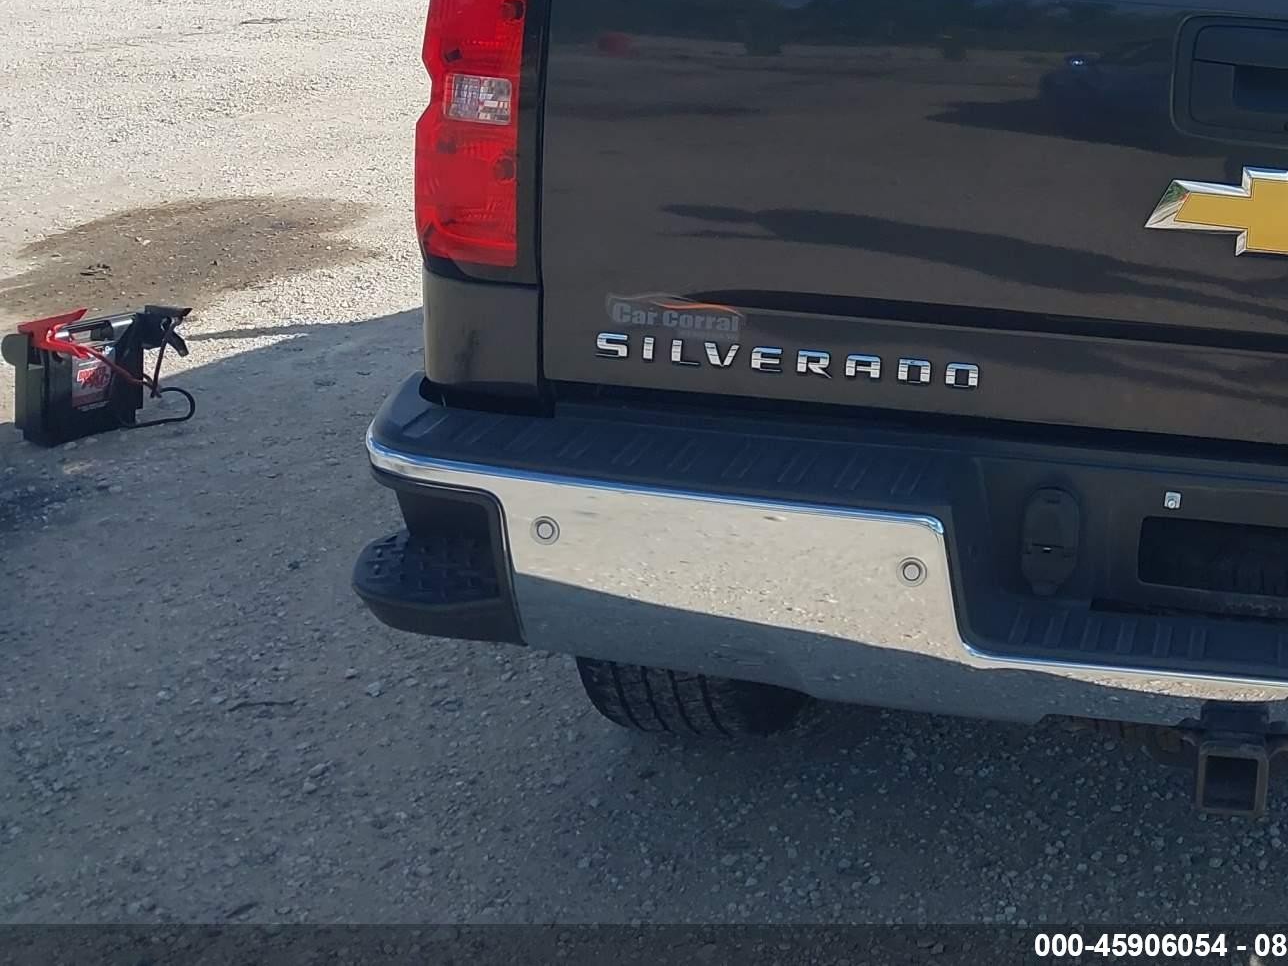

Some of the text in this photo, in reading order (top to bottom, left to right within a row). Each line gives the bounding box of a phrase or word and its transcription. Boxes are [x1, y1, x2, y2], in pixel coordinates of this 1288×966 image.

[613, 302, 739, 332] Car Corral
[595, 332, 980, 389] SILVERADO
